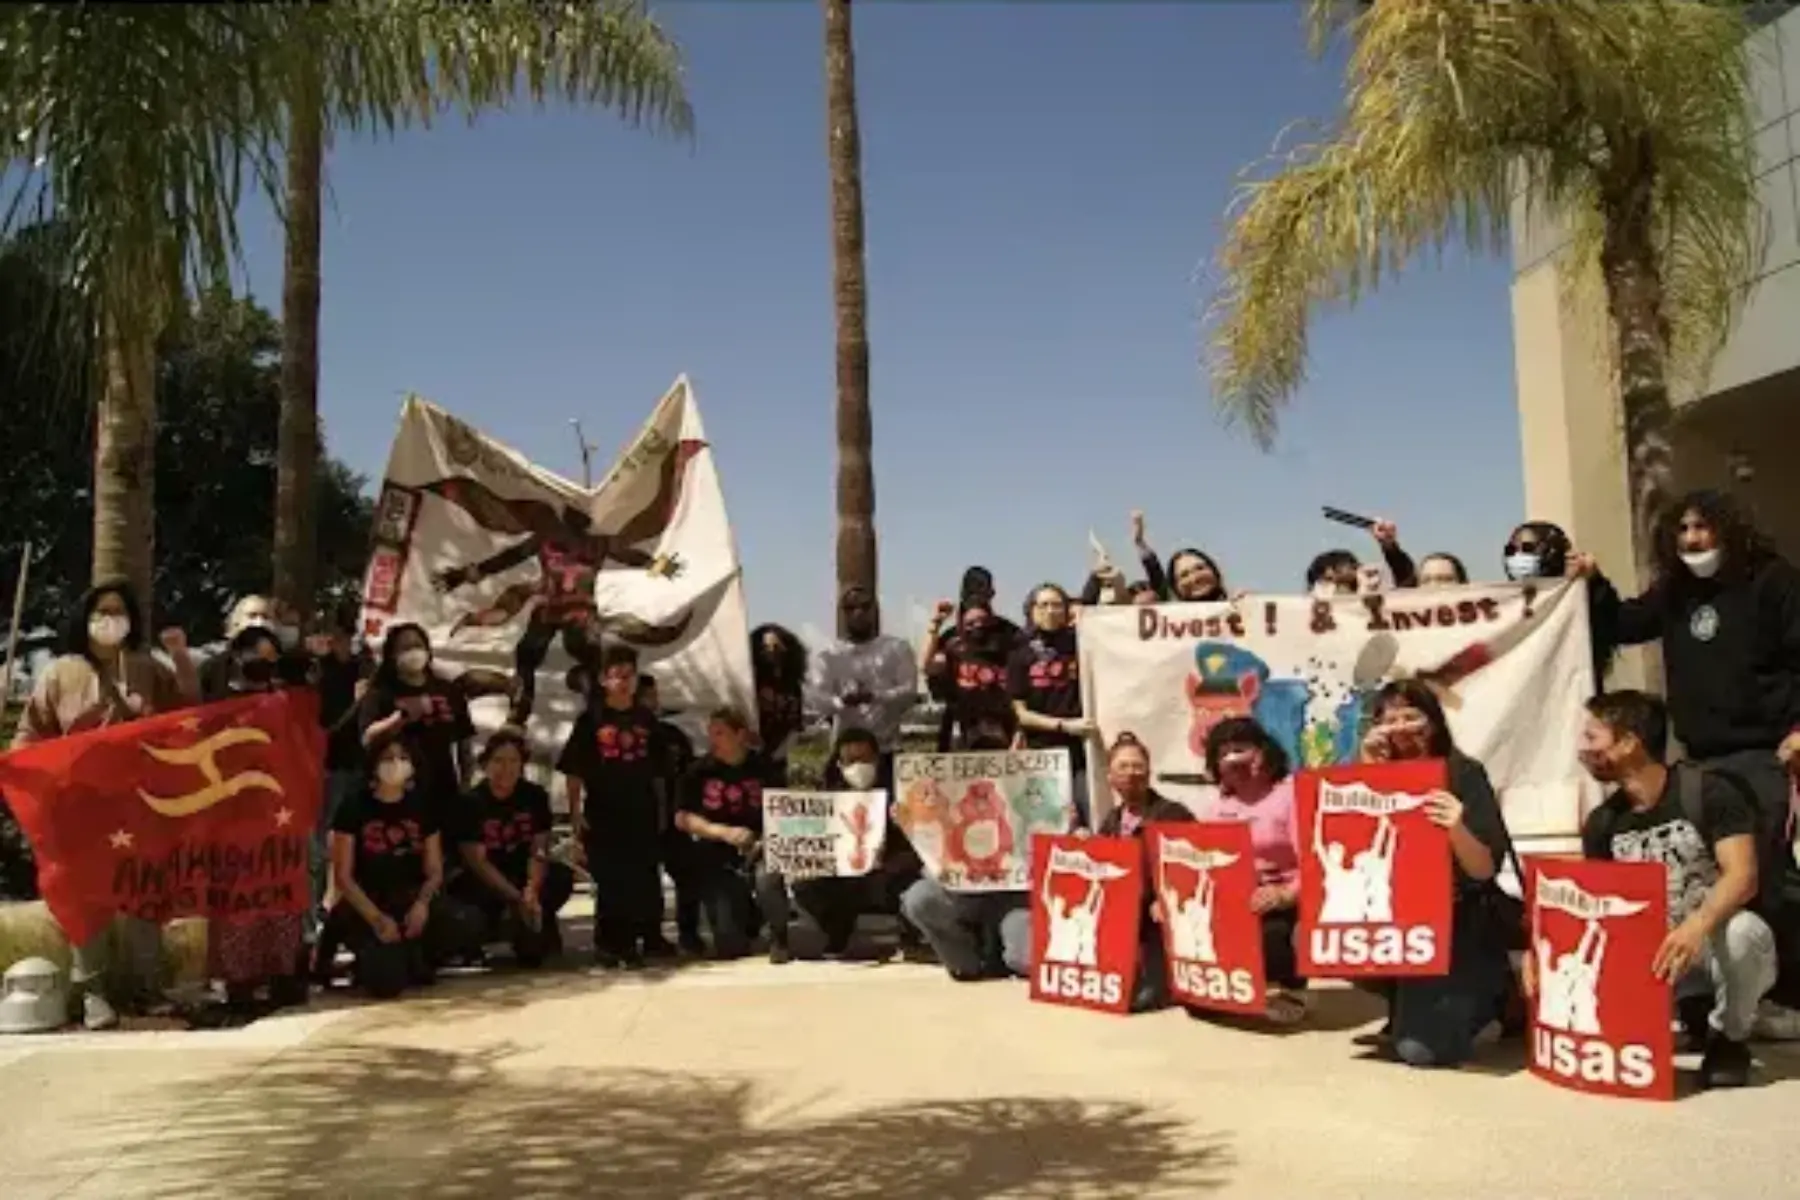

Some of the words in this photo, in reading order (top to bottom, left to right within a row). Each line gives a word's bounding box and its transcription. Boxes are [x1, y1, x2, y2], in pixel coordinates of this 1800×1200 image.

[1139, 607, 1245, 640] Divest
[1309, 600, 1337, 634] &
[1364, 597, 1500, 632] Invest
[1310, 925, 1436, 965] usas
[1040, 963, 1122, 1003] usas
[1173, 959, 1256, 1003] usas
[1534, 1025, 1656, 1088] usas
